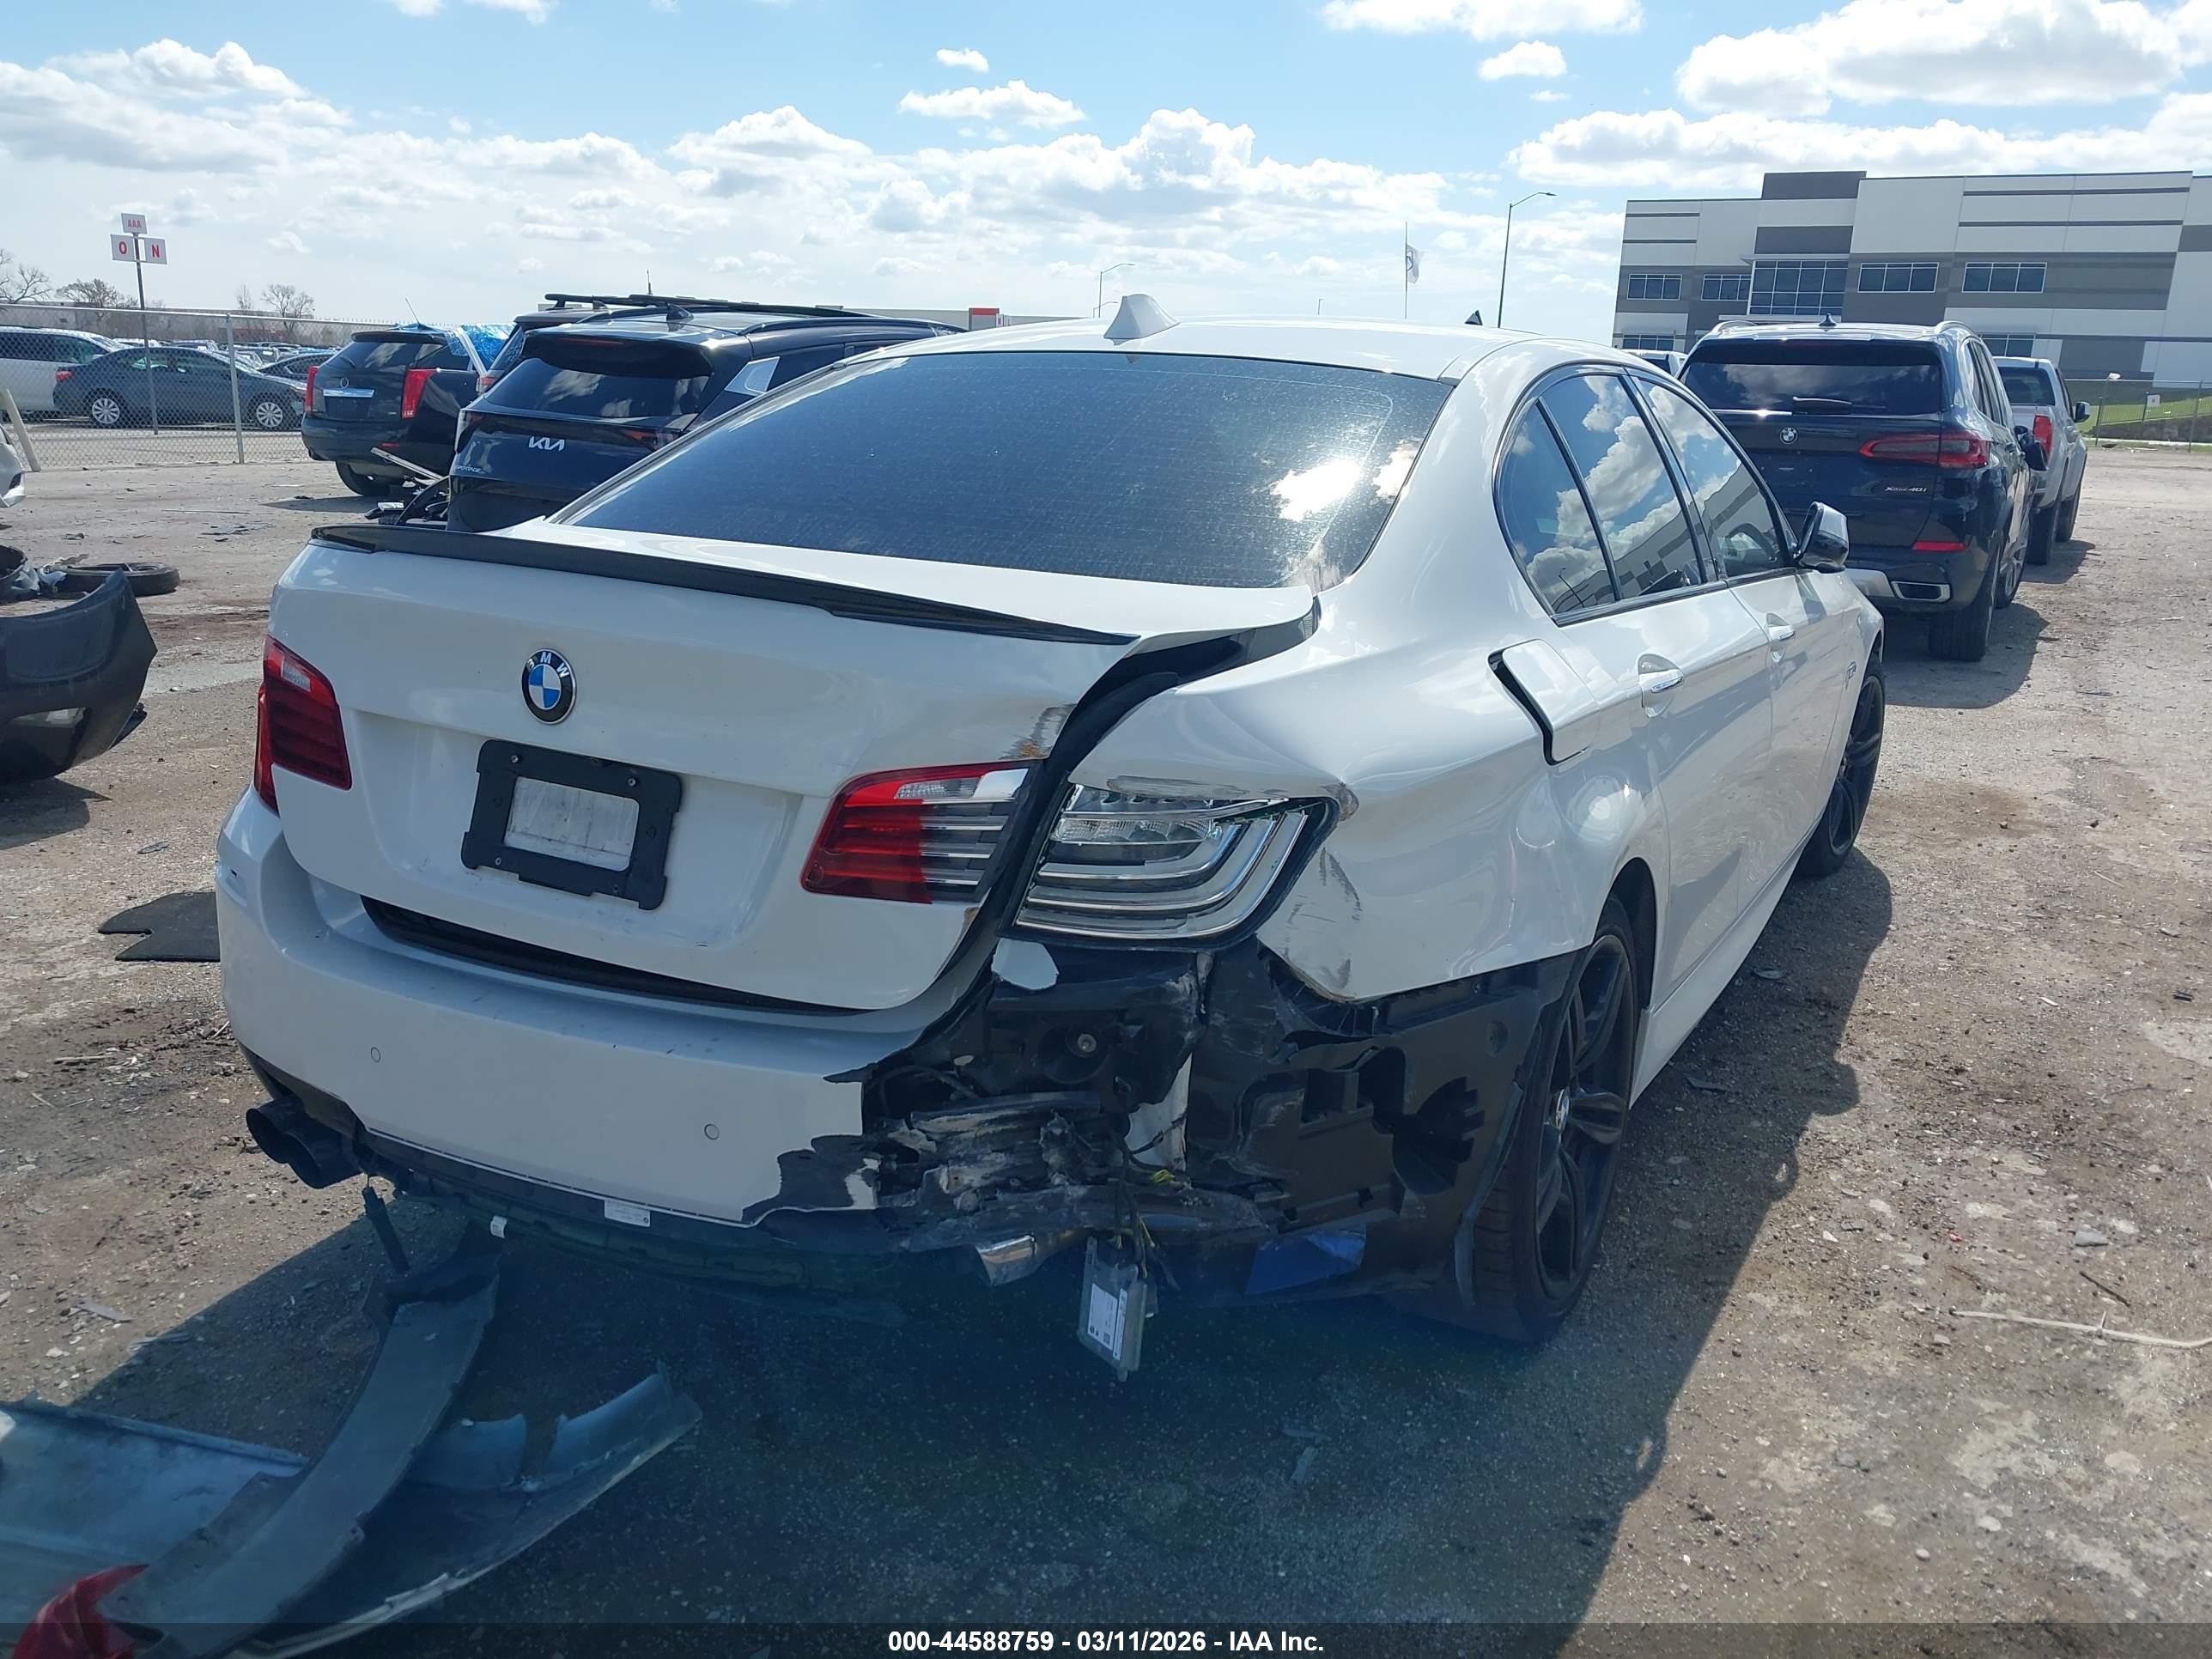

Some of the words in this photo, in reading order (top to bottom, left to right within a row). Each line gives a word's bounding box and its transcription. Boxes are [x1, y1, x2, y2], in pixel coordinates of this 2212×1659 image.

[128, 219, 143, 228] AAA
[118, 240, 128, 255] O
[151, 244, 161, 258] N
[526, 652, 571, 678] BMW
